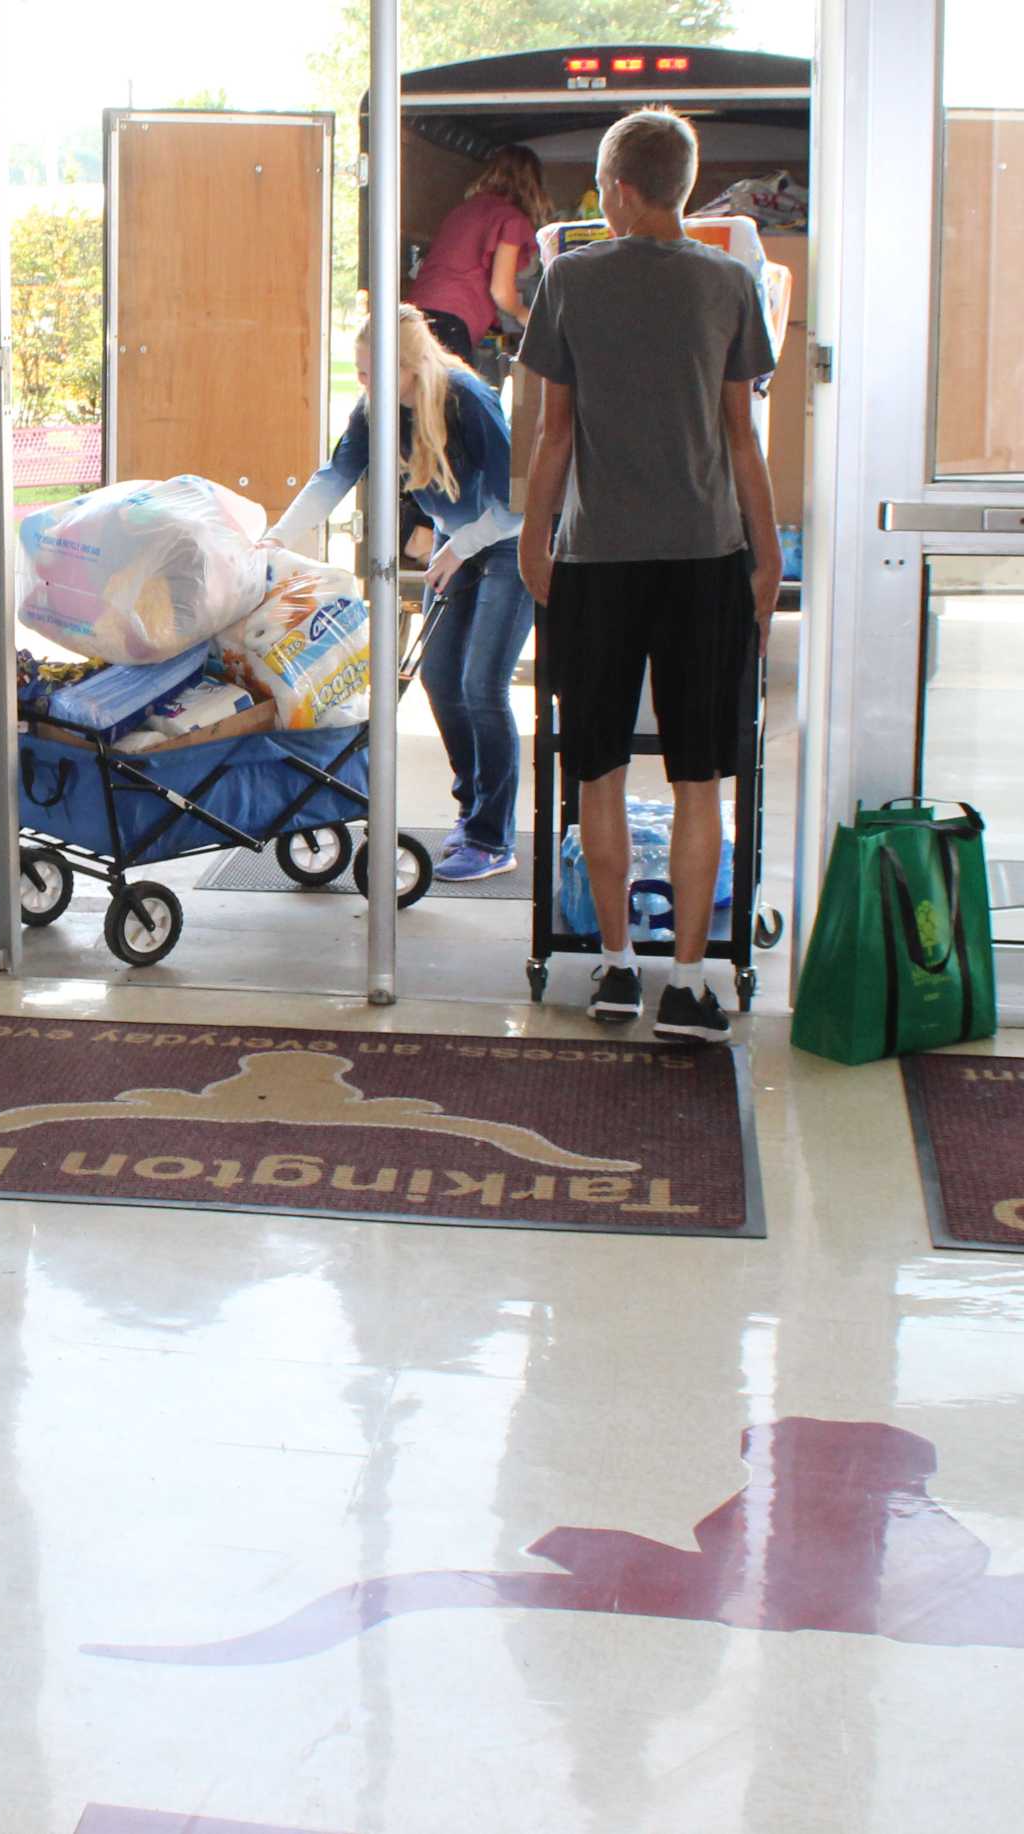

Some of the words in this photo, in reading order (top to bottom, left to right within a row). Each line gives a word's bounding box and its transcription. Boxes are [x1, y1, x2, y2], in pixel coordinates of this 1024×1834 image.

[92, 1029, 337, 1052] everyday
[358, 1041, 422, 1056] an
[59, 1151, 700, 1213] Tarkington
